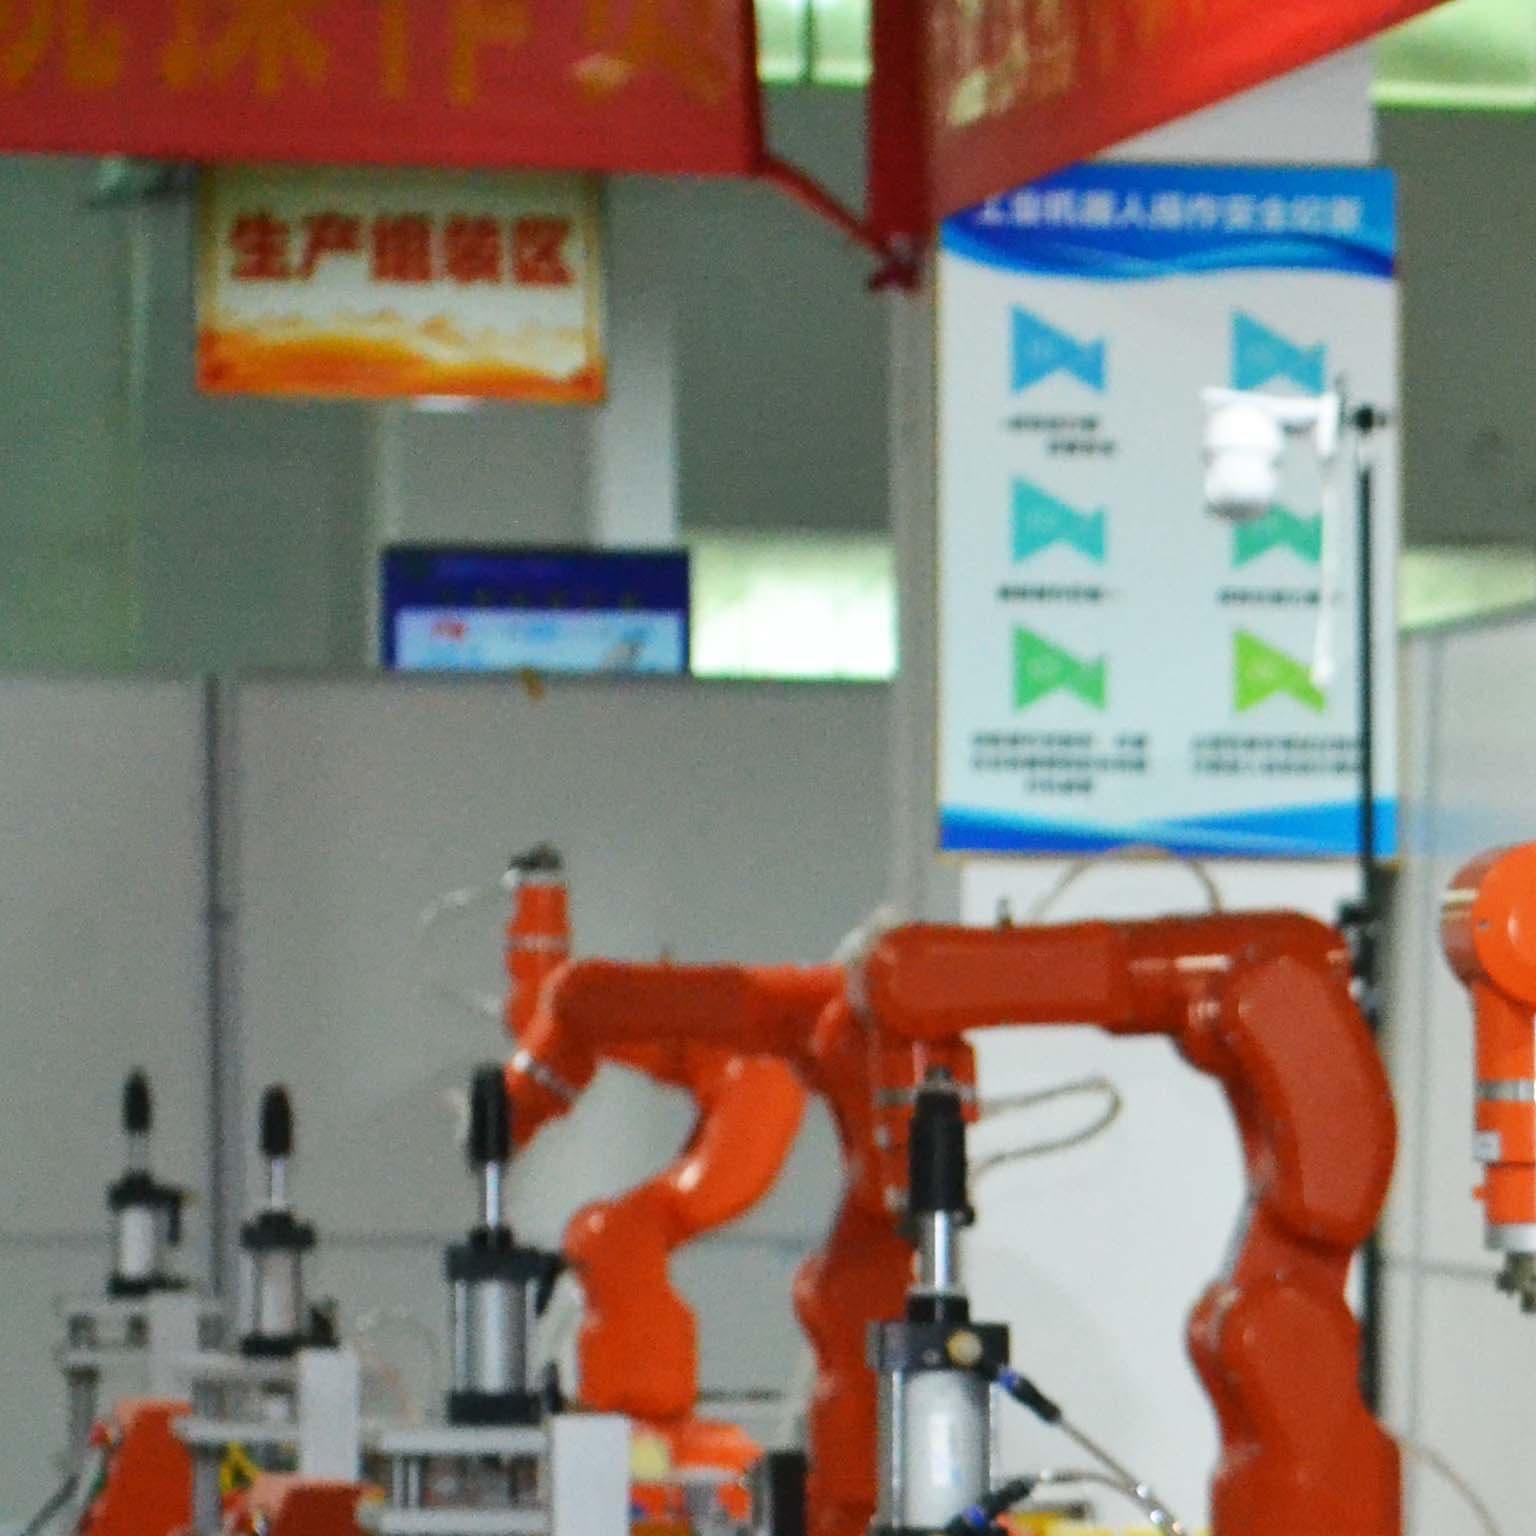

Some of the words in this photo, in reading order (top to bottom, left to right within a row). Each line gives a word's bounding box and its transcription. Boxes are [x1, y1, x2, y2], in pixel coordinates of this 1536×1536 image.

[229, 208, 579, 288] 生产组装区
